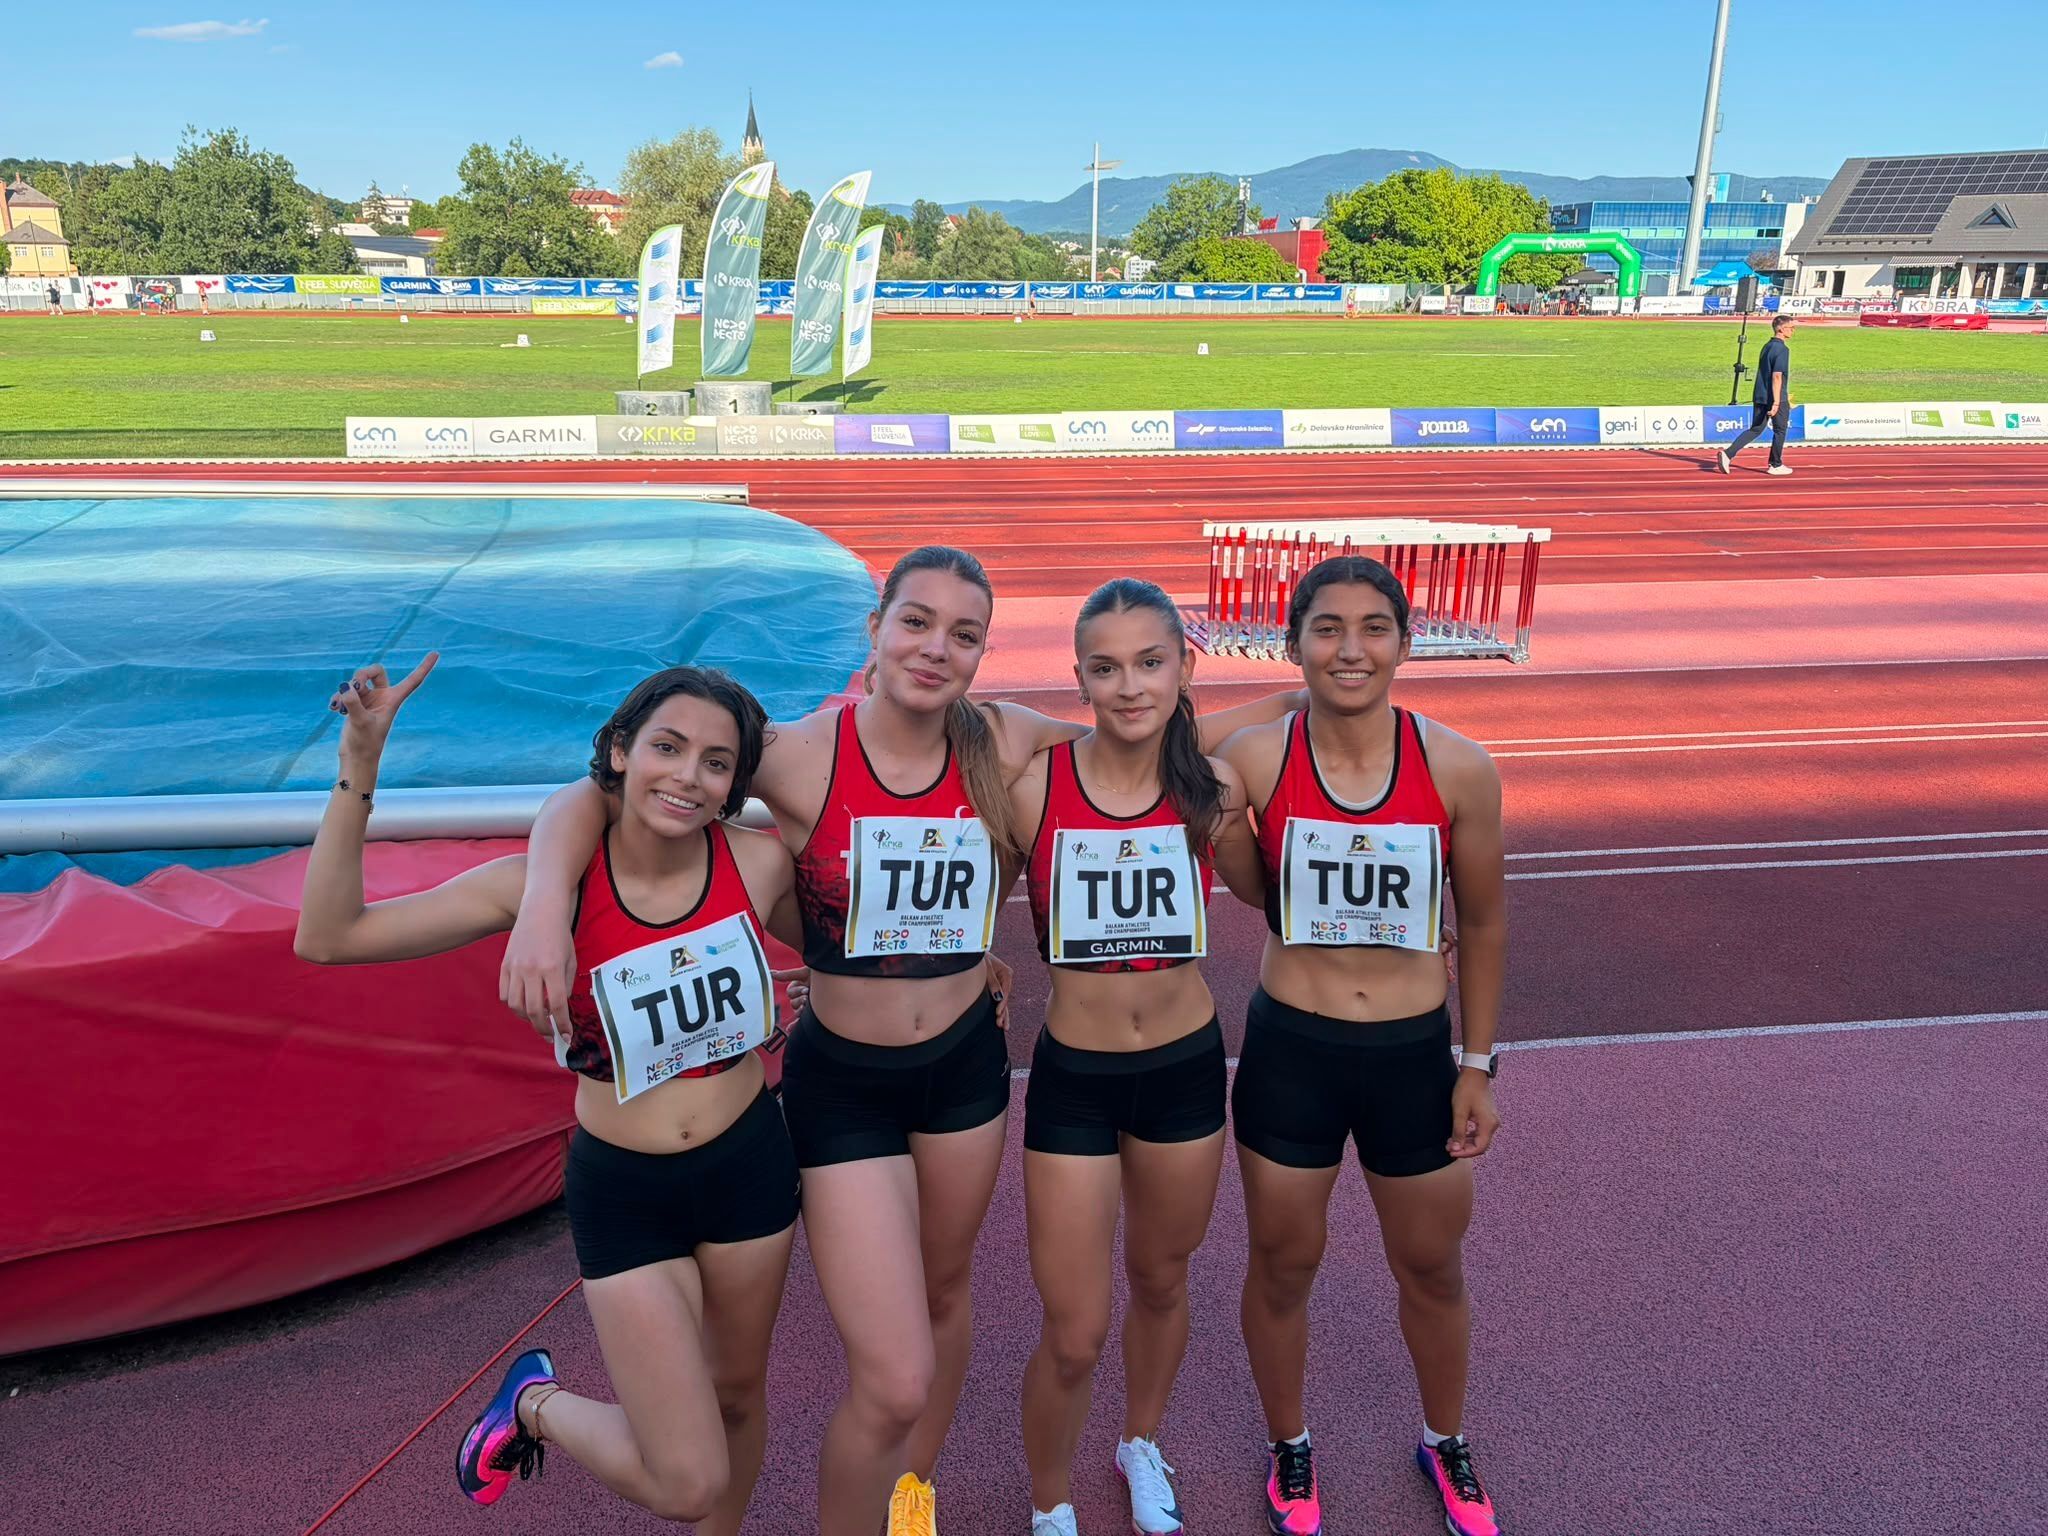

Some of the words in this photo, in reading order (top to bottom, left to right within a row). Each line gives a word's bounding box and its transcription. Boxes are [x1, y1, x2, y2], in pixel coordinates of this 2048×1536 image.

[390, 281, 432, 289] GARMIN
[728, 276, 754, 288] KRKA
[818, 279, 842, 293] KRKA
[1120, 287, 1156, 295] GARMIN
[1908, 301, 1968, 312] KOBRA
[645, 402, 658, 416] 2
[729, 399, 738, 413] 1
[790, 428, 826, 440] KRKA
[1310, 424, 1345, 432] Delavska
[1347, 423, 1384, 432] Hranilnica
[489, 428, 583, 443] GARMIN
[880, 860, 974, 911] TUR
[1308, 859, 1410, 909] TUR
[1077, 867, 1177, 919] TUR
[1090, 939, 1164, 954] GARMIN
[631, 966, 745, 1047] TUR
